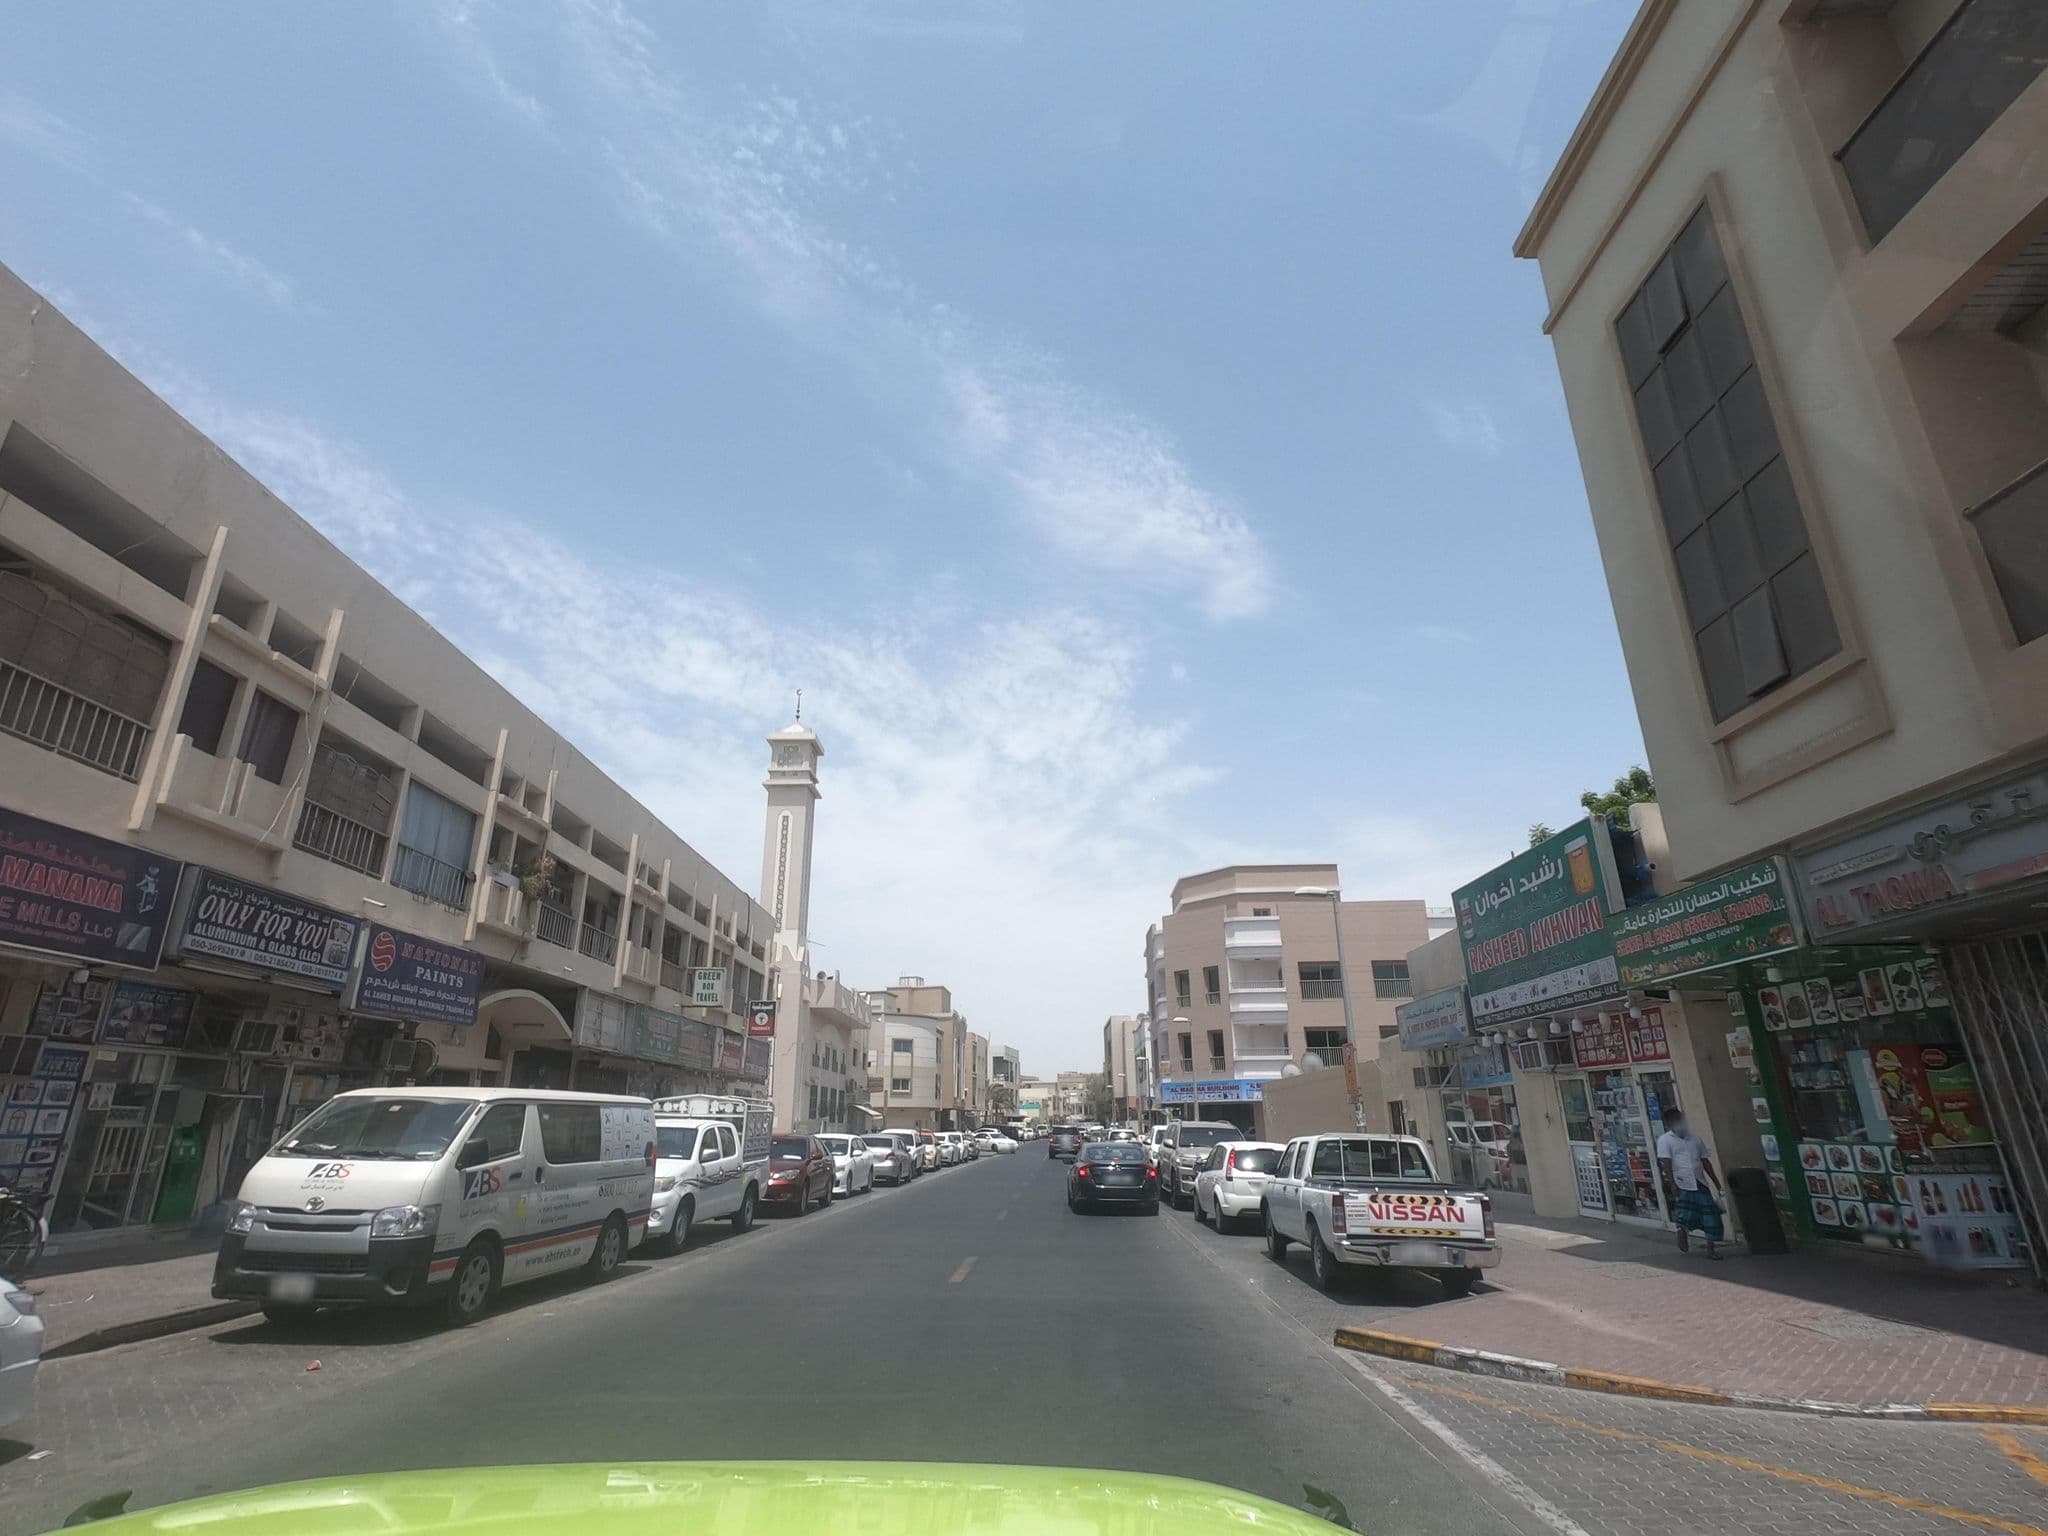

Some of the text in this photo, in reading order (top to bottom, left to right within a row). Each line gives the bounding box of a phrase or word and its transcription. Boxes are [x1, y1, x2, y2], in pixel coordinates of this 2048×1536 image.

[0, 854, 124, 913] MANAMA
[1519, 855, 1564, 893] رشيد
[1731, 865, 1777, 897] شكيب
[1474, 877, 1516, 916] اخوان
[1648, 900, 1684, 924] للتجارة
[1686, 884, 1729, 912] الحسان
[1816, 896, 1849, 928] AL
[1849, 865, 1957, 915] TAQWA
[17, 900, 81, 932] MILLS
[83, 921, 114, 939] LLC
[198, 894, 329, 949] ONLY FOR YOU
[1624, 915, 1648, 930] عامة
[1683, 910, 1727, 935] GENERAL
[1727, 894, 1772, 923] TRADING
[1772, 898, 1785, 912] LLC
[193, 922, 322, 963] ALUMINIUM & GLASS (LLC)
[1468, 928, 1529, 974] RASHEED
[1530, 896, 1604, 953] AKHWAN
[401, 942, 481, 975] NATIONAL
[415, 966, 464, 988] PAINTS
[697, 971, 722, 981] GREEN
[696, 993, 719, 1003] TRAVEL
[308, 1163, 354, 1179] ABS
[464, 1166, 502, 1200] ABS
[1368, 1203, 1465, 1223] NISSAN
